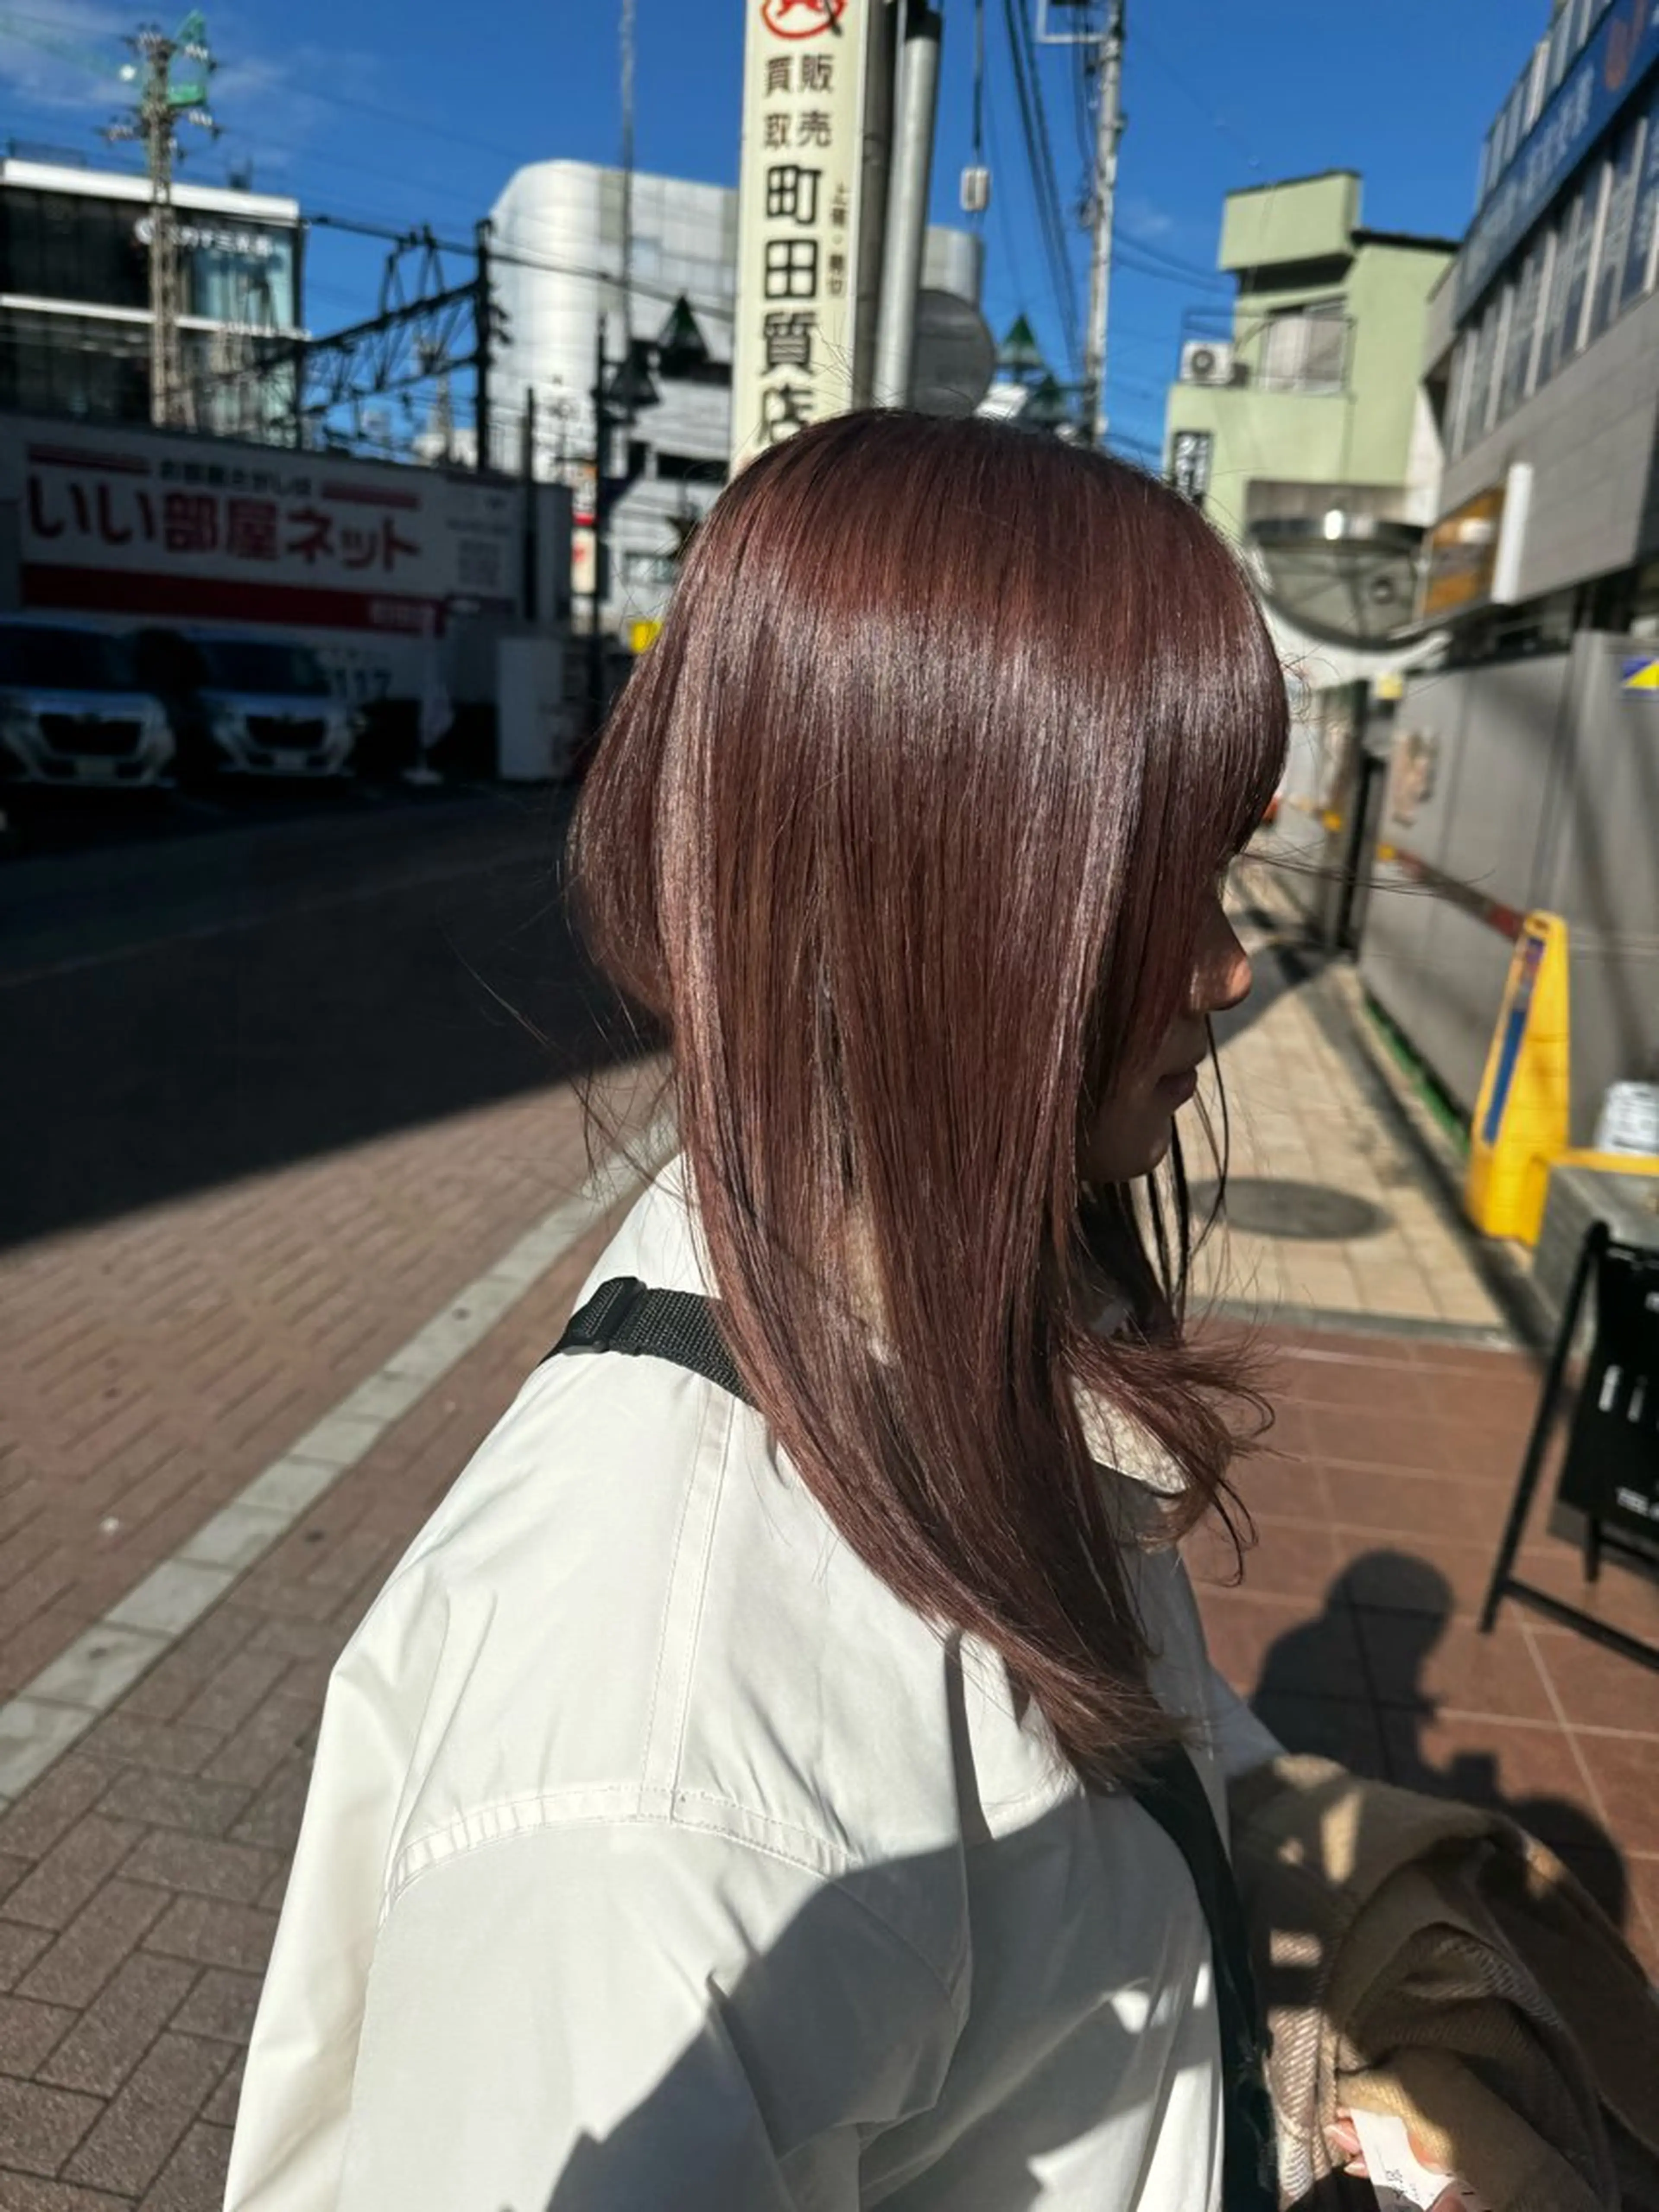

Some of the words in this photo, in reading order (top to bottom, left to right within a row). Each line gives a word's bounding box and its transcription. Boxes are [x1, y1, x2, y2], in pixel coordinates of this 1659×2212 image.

[755, 164, 822, 445] 町田質店
[28, 475, 420, 572] いい部屋ネット
